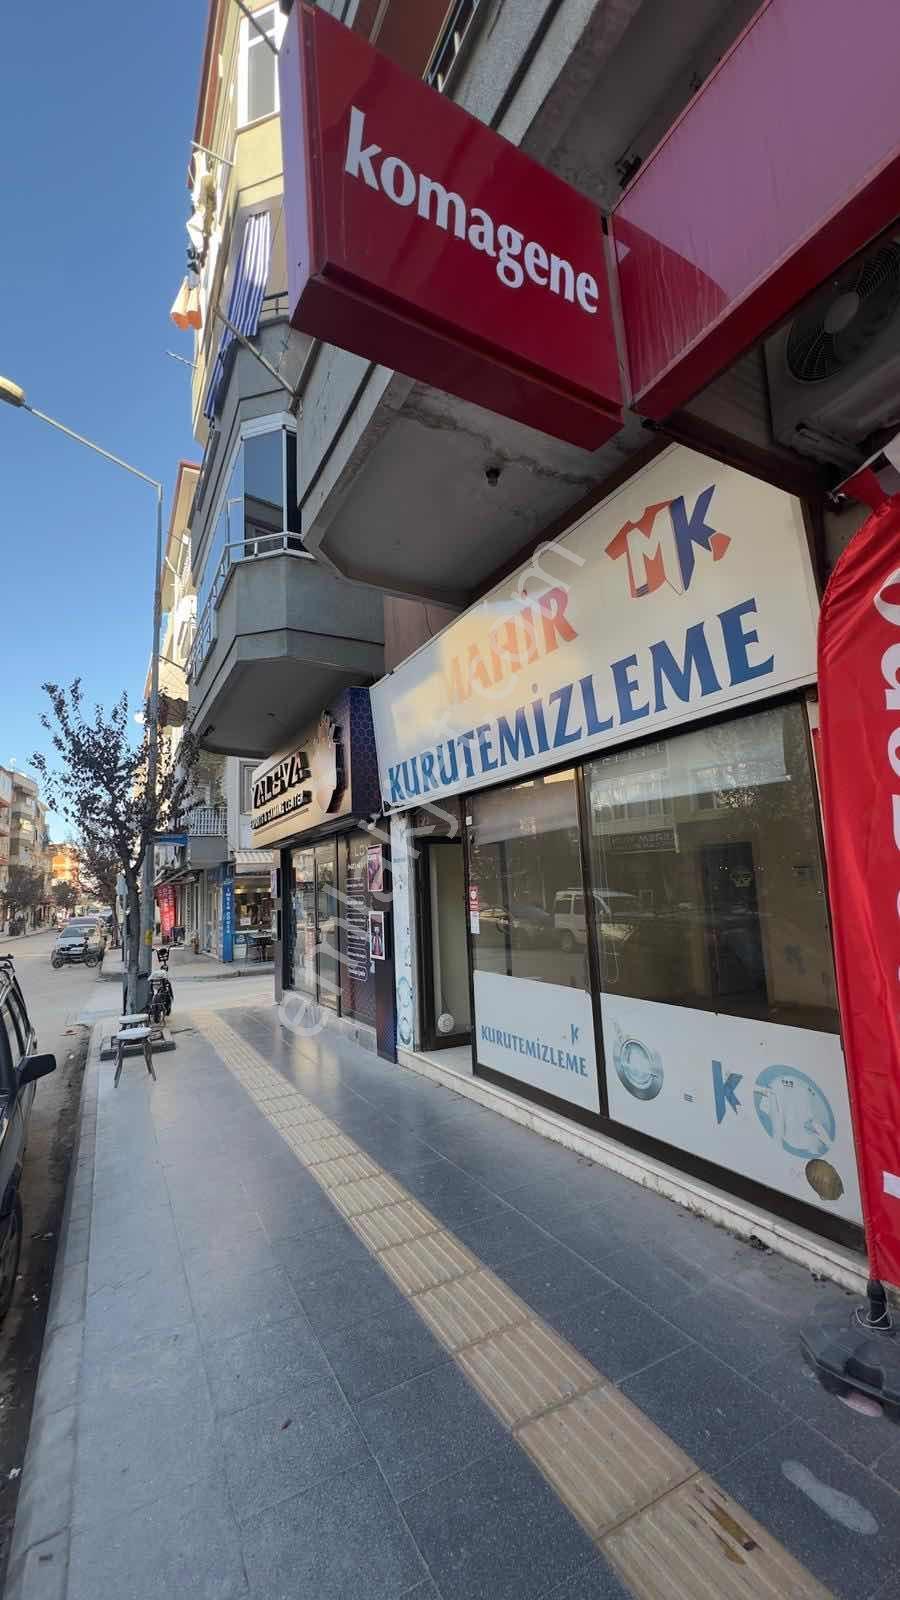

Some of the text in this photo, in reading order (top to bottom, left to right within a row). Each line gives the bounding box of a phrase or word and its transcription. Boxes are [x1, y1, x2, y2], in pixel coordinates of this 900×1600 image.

[344, 104, 599, 314] komagene
[614, 484, 731, 598] MK
[387, 597, 775, 804] KURUTEMİZLEME
[480, 1023, 588, 1077] KURUTEMİZLEME
